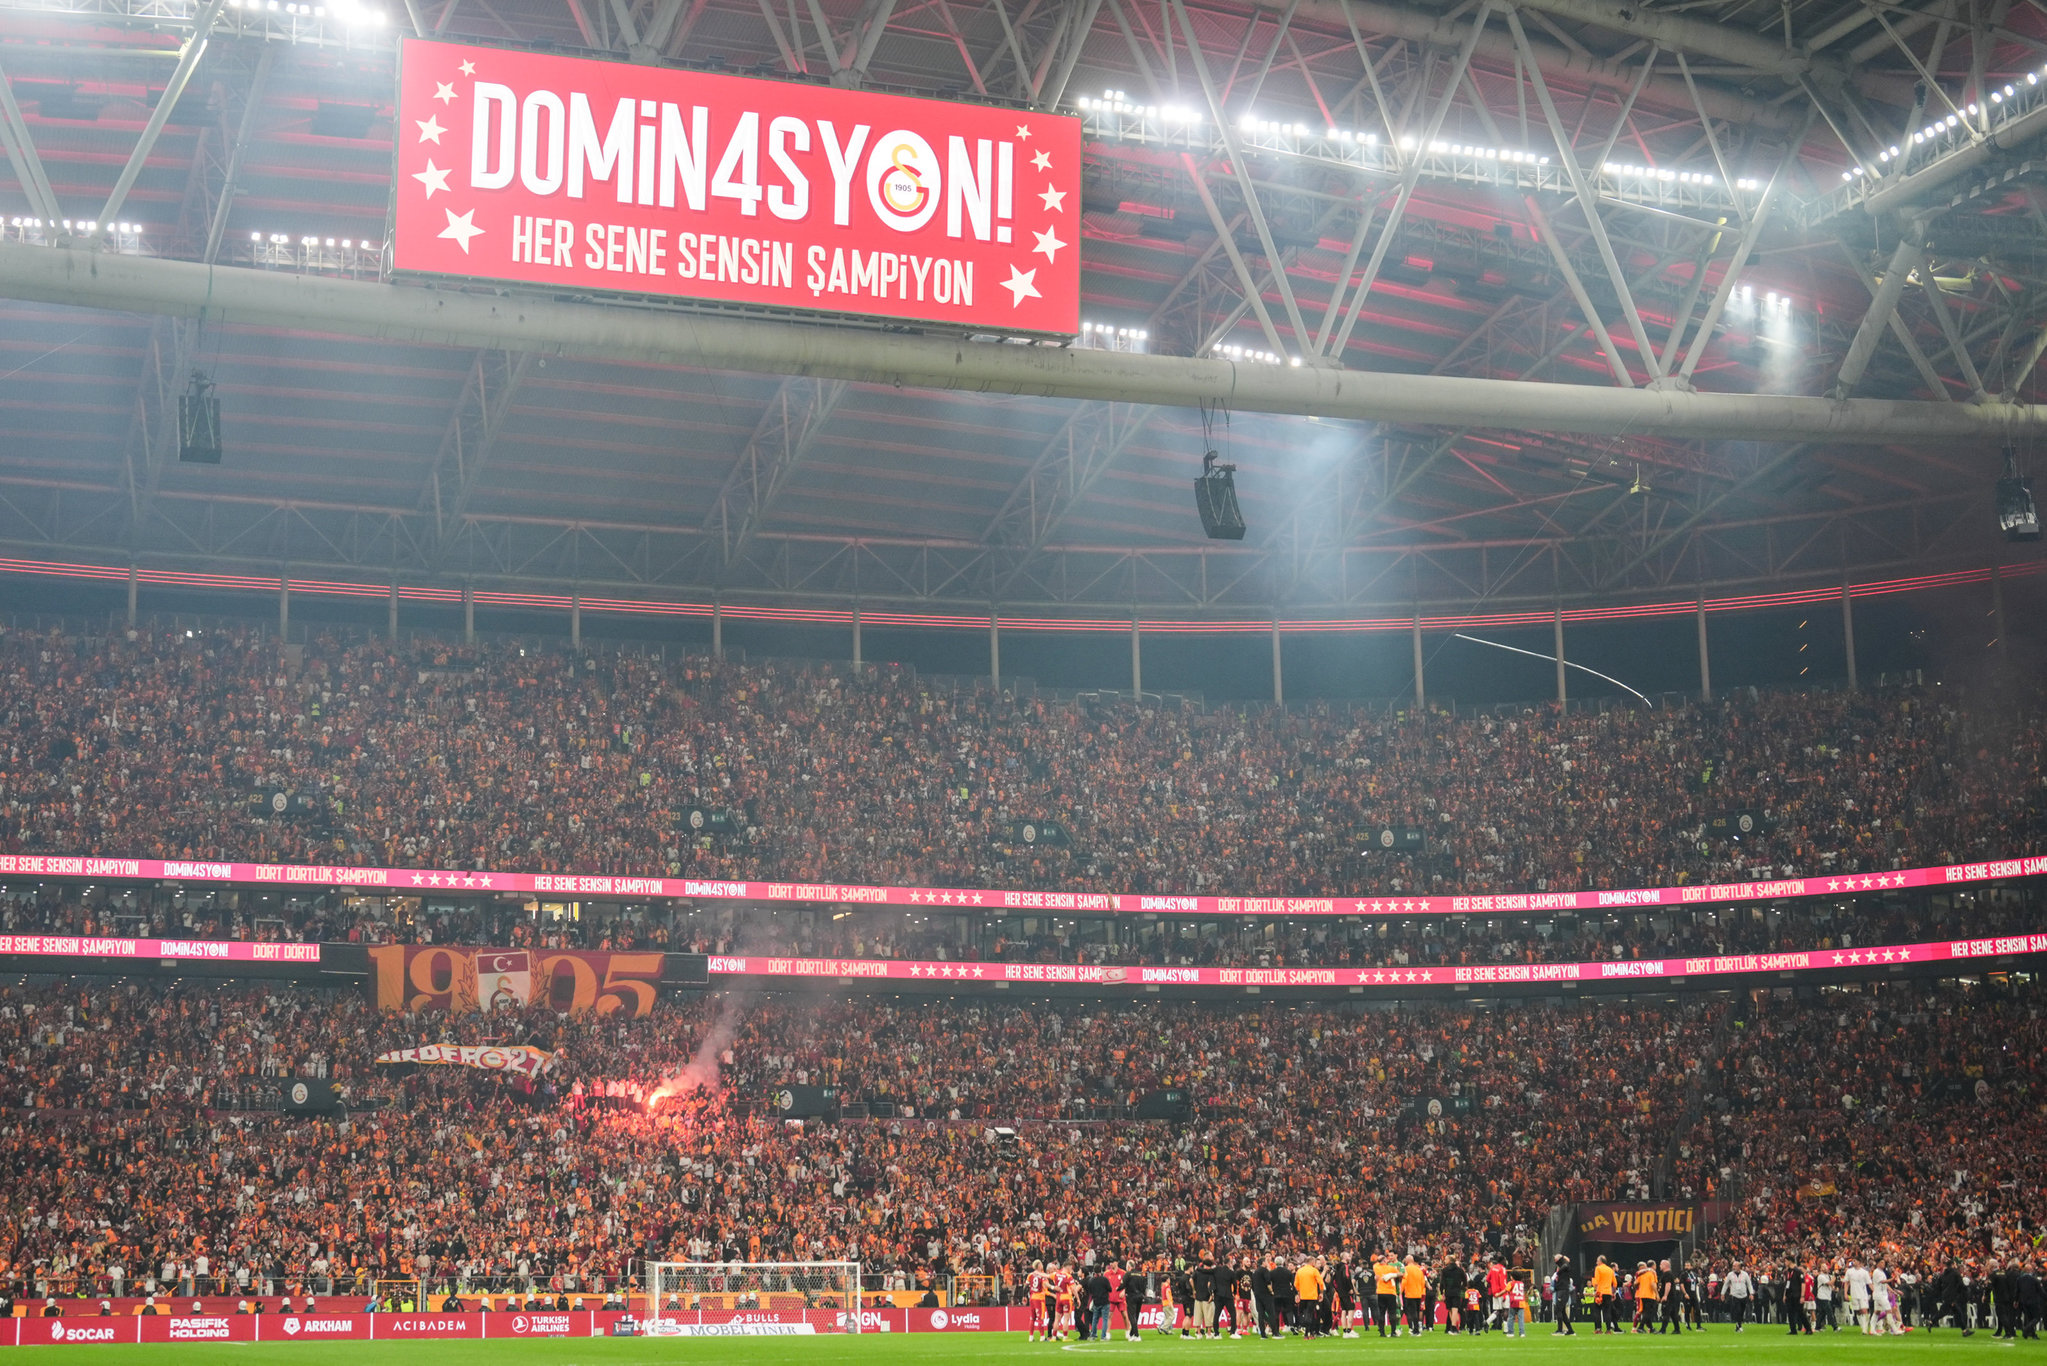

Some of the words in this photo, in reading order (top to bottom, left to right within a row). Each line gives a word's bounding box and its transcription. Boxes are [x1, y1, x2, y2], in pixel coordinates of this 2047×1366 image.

[512, 215, 575, 268] HER
[585, 222, 666, 277] SENE
[1355, 832, 1369, 841] 425
[19, 857, 44, 871] SENE
[1946, 867, 1963, 881] HER
[1966, 865, 1988, 879] SENE
[535, 876, 552, 890] HER
[554, 877, 577, 891] SENE
[1005, 893, 1020, 905] HER
[1022, 894, 1043, 906] SENE
[1453, 898, 1469, 910] HER
[1471, 897, 1493, 910] SENE
[0, 937, 12, 951] ER
[15, 938, 40, 951] SENE
[1952, 943, 1968, 956] HER
[1971, 941, 1993, 955] SENE
[1006, 966, 1021, 978] HER
[1022, 966, 1044, 979] SENE
[1456, 969, 1472, 980] HER
[1474, 968, 1496, 980] SENE
[1611, 1207, 1694, 1234] YURTİÇİ
[531, 1315, 569, 1324] TURKISH
[746, 1313, 780, 1323] BULLS
[951, 1313, 980, 1327] Lydia
[304, 1319, 352, 1332] ARKHAM
[393, 1320, 466, 1331] ACIBADEM
[531, 1324, 570, 1332] AIRLINES
[66, 1328, 115, 1341] SOCAR
[170, 1329, 230, 1338] HOLDING
